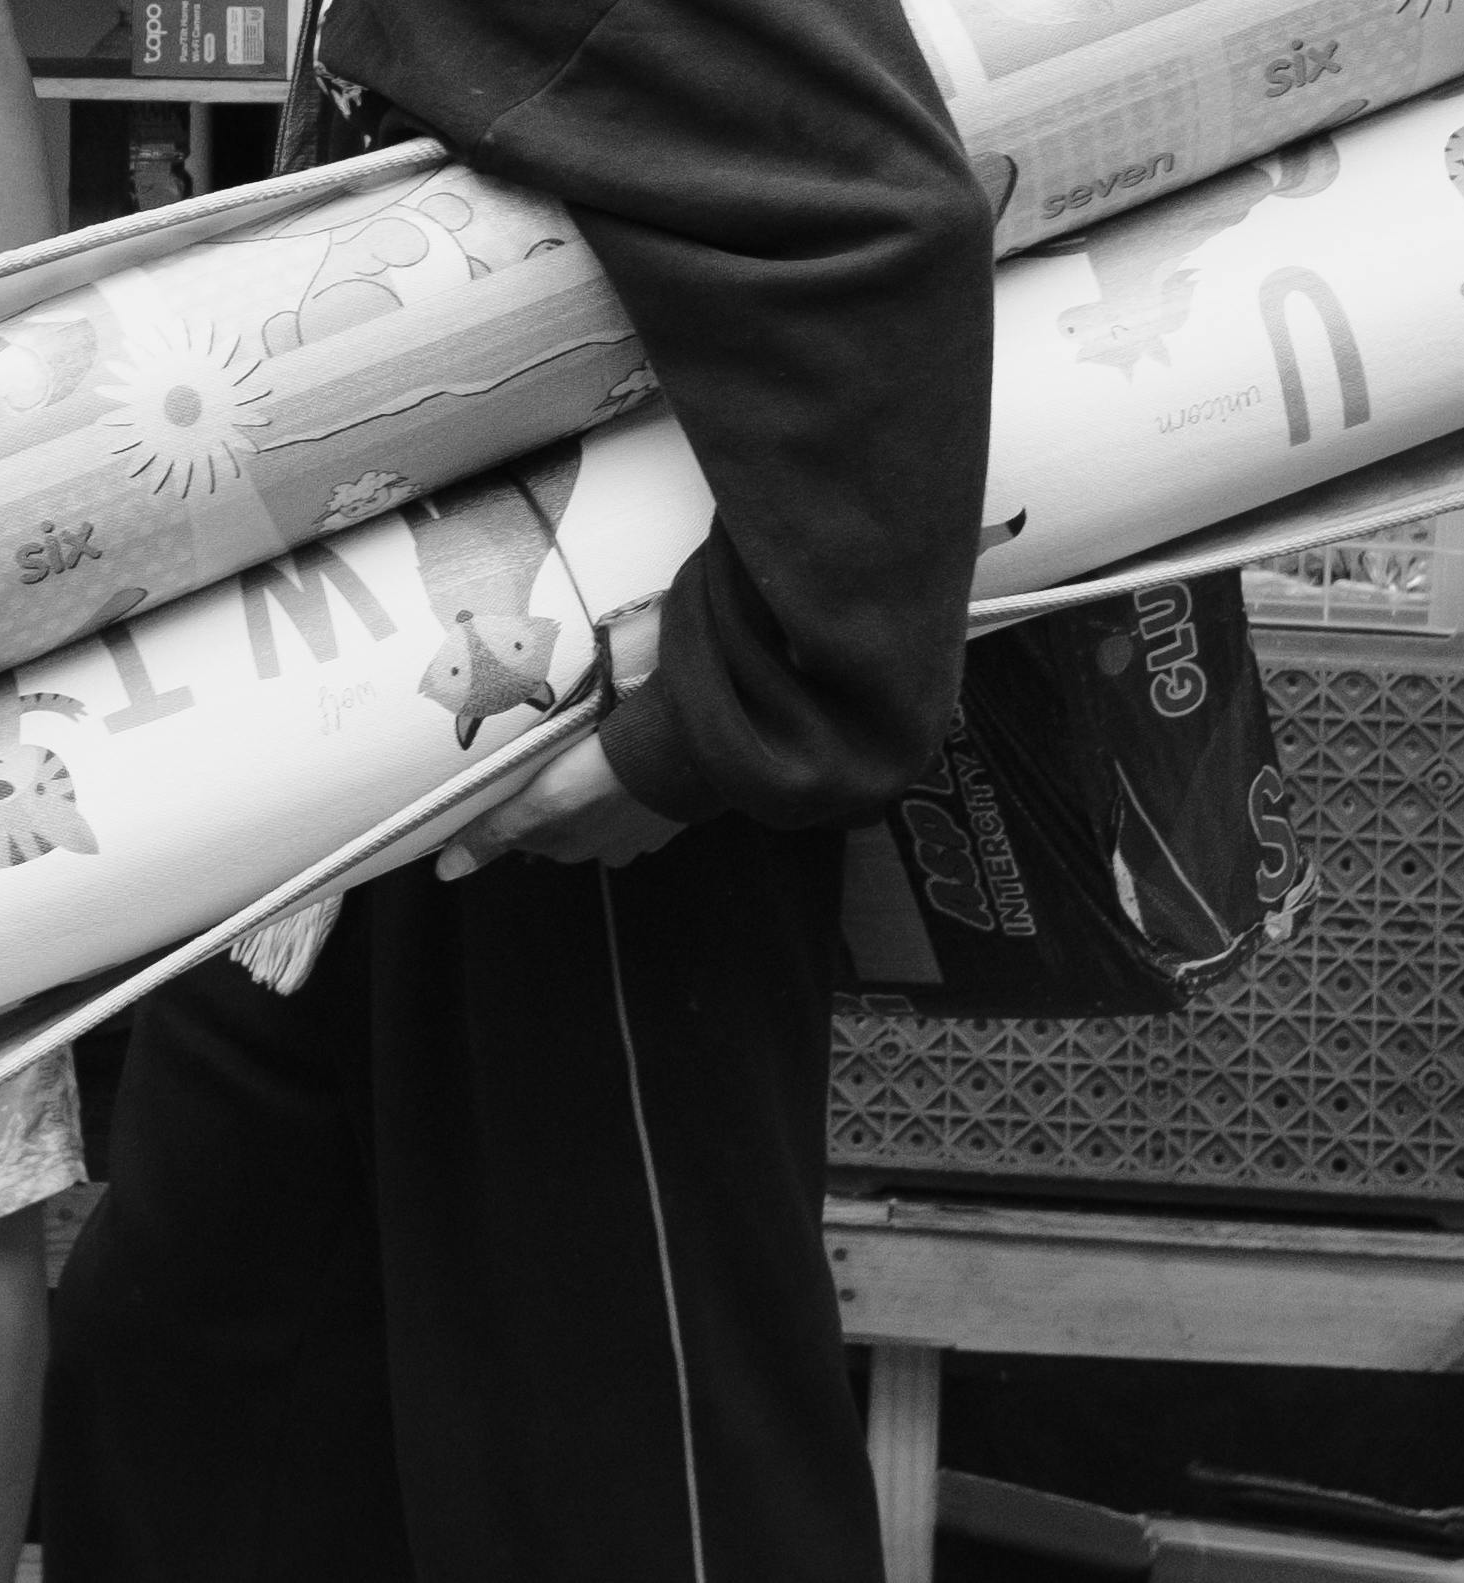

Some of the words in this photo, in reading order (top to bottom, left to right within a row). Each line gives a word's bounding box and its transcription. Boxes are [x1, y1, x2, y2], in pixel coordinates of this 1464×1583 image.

[143, 2, 168, 64] tapo
[1264, 37, 1343, 99] six
[1041, 149, 1175, 220] seven
[1259, 266, 1372, 448] U
[1154, 384, 1262, 434] unicorn
[14, 518, 104, 586] six
